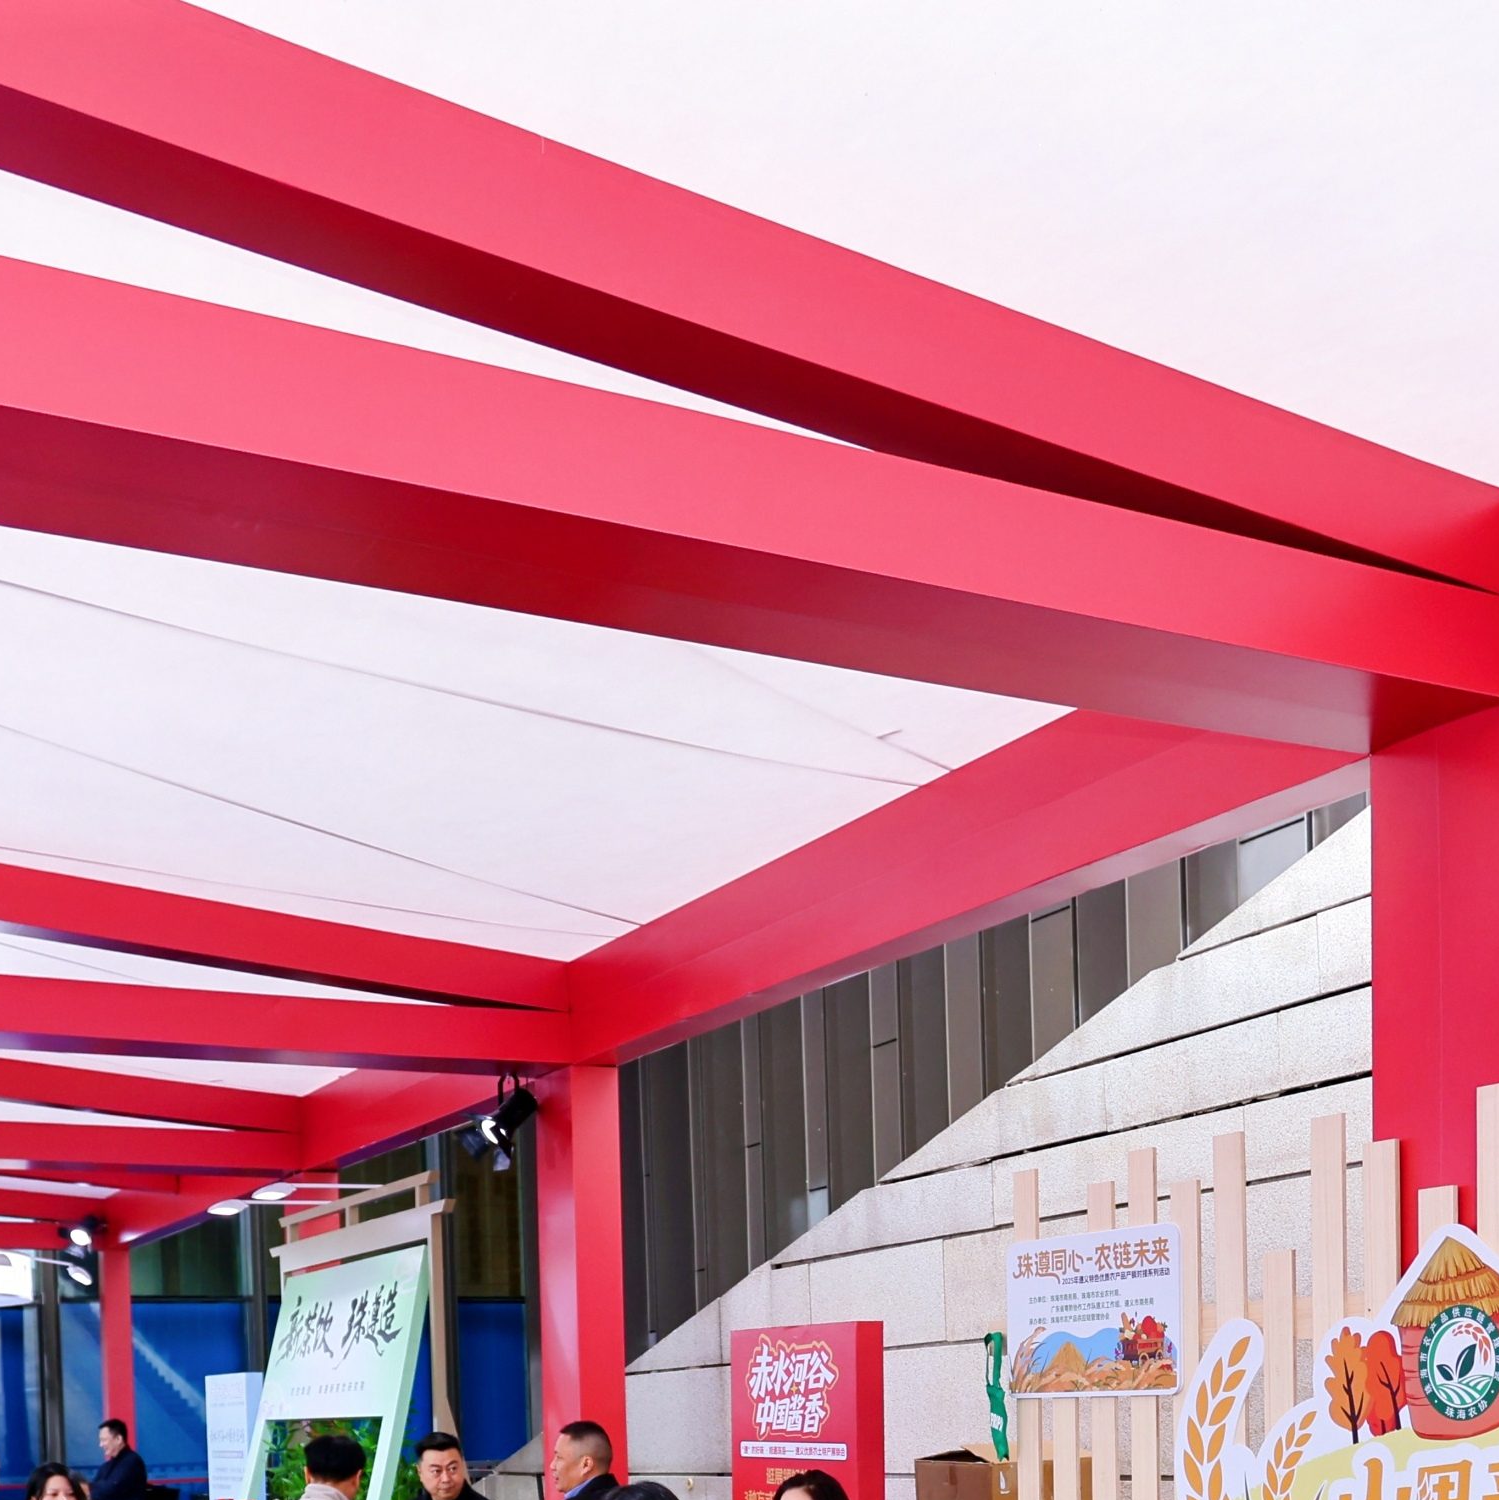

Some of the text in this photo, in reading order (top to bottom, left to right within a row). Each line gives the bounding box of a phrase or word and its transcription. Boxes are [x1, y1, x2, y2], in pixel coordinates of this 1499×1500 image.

[749, 1342, 836, 1400] 赤水河谷
[756, 1391, 826, 1436] 中国酱香
